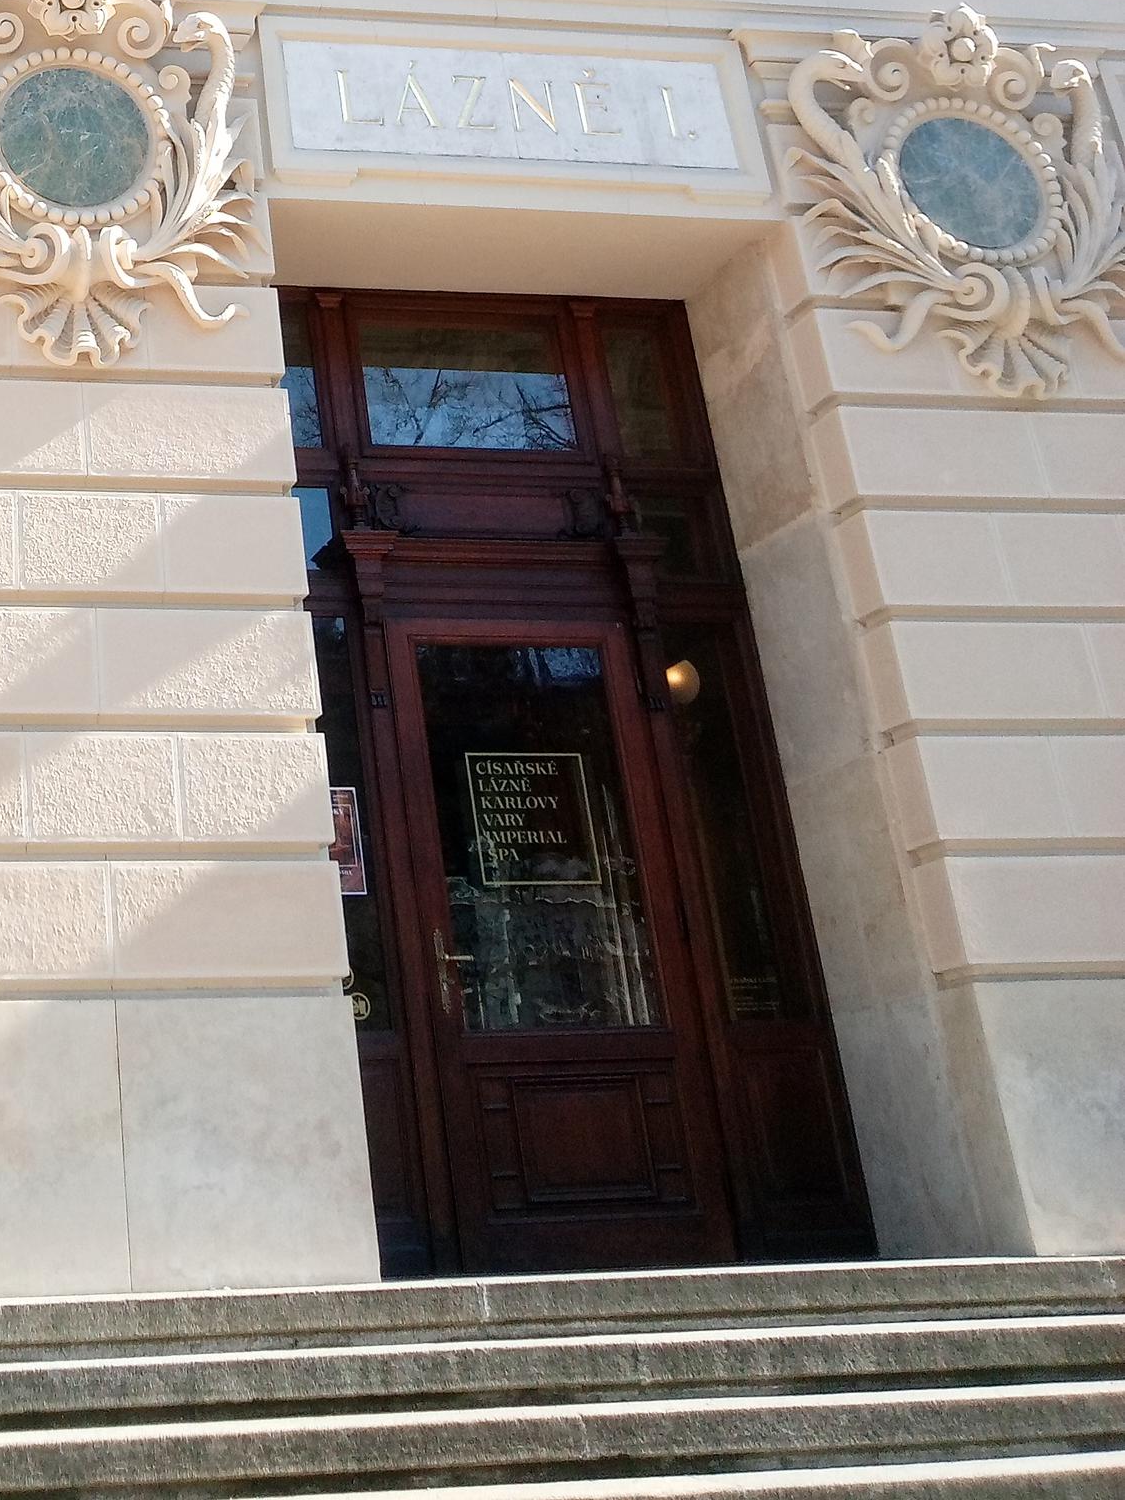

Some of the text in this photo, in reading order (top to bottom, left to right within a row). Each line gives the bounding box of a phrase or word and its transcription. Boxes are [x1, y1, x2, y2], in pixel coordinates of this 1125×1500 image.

[660, 85, 700, 141] I.
[480, 795, 559, 810] KARLOVY
[483, 812, 526, 827] VARY
[486, 830, 567, 845] IMPERIAL
[488, 847, 520, 861] SPA
